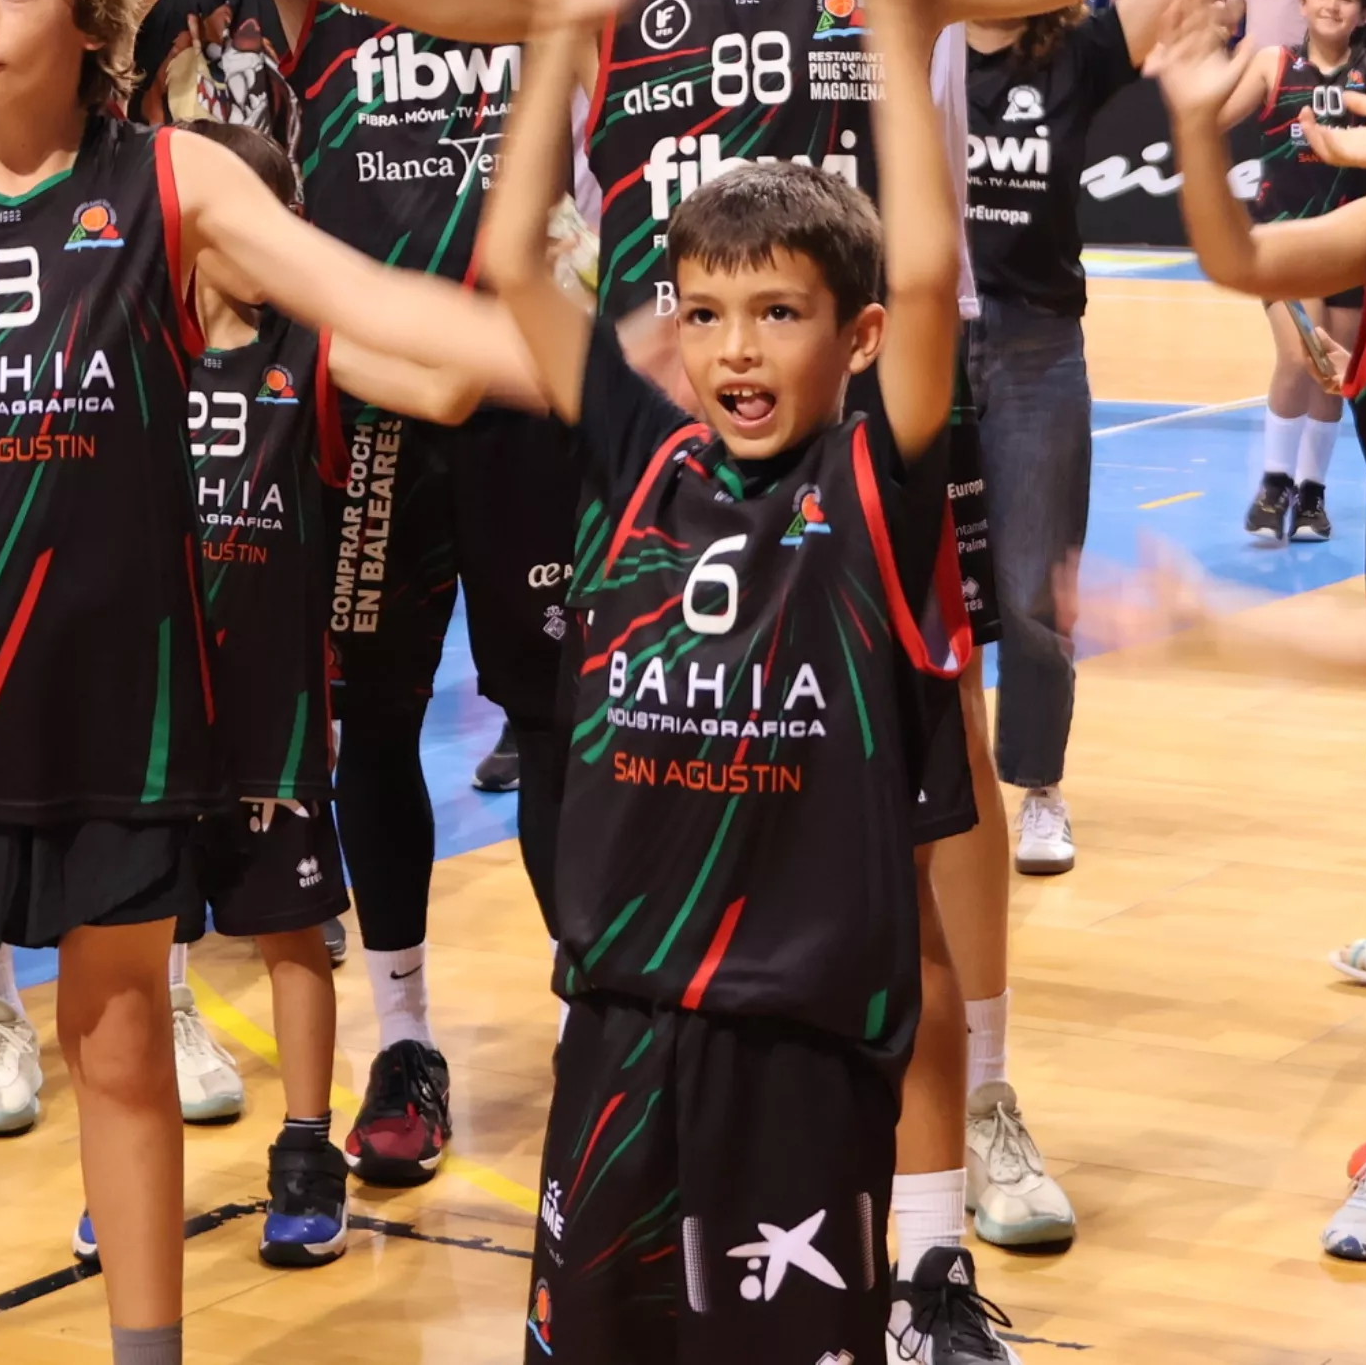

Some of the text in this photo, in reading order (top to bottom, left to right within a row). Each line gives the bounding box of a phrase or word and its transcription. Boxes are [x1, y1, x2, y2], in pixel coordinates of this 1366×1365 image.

[711, 30, 792, 108] 88
[809, 62, 841, 81] PUIG
[623, 79, 696, 116] alsa
[810, 82, 886, 102] MAGDALENA
[358, 111, 398, 127] FIBRA
[405, 106, 449, 124] MÓVIL
[456, 105, 473, 119] TV
[965, 203, 1031, 226] irEuropa
[198, 477, 284, 513] HIA
[330, 505, 363, 632] COMPRAR
[682, 533, 749, 635] 6
[353, 589, 382, 633] EN
[607, 650, 827, 711] BAHIA
[614, 751, 801, 794] SAN AGUSTIN
